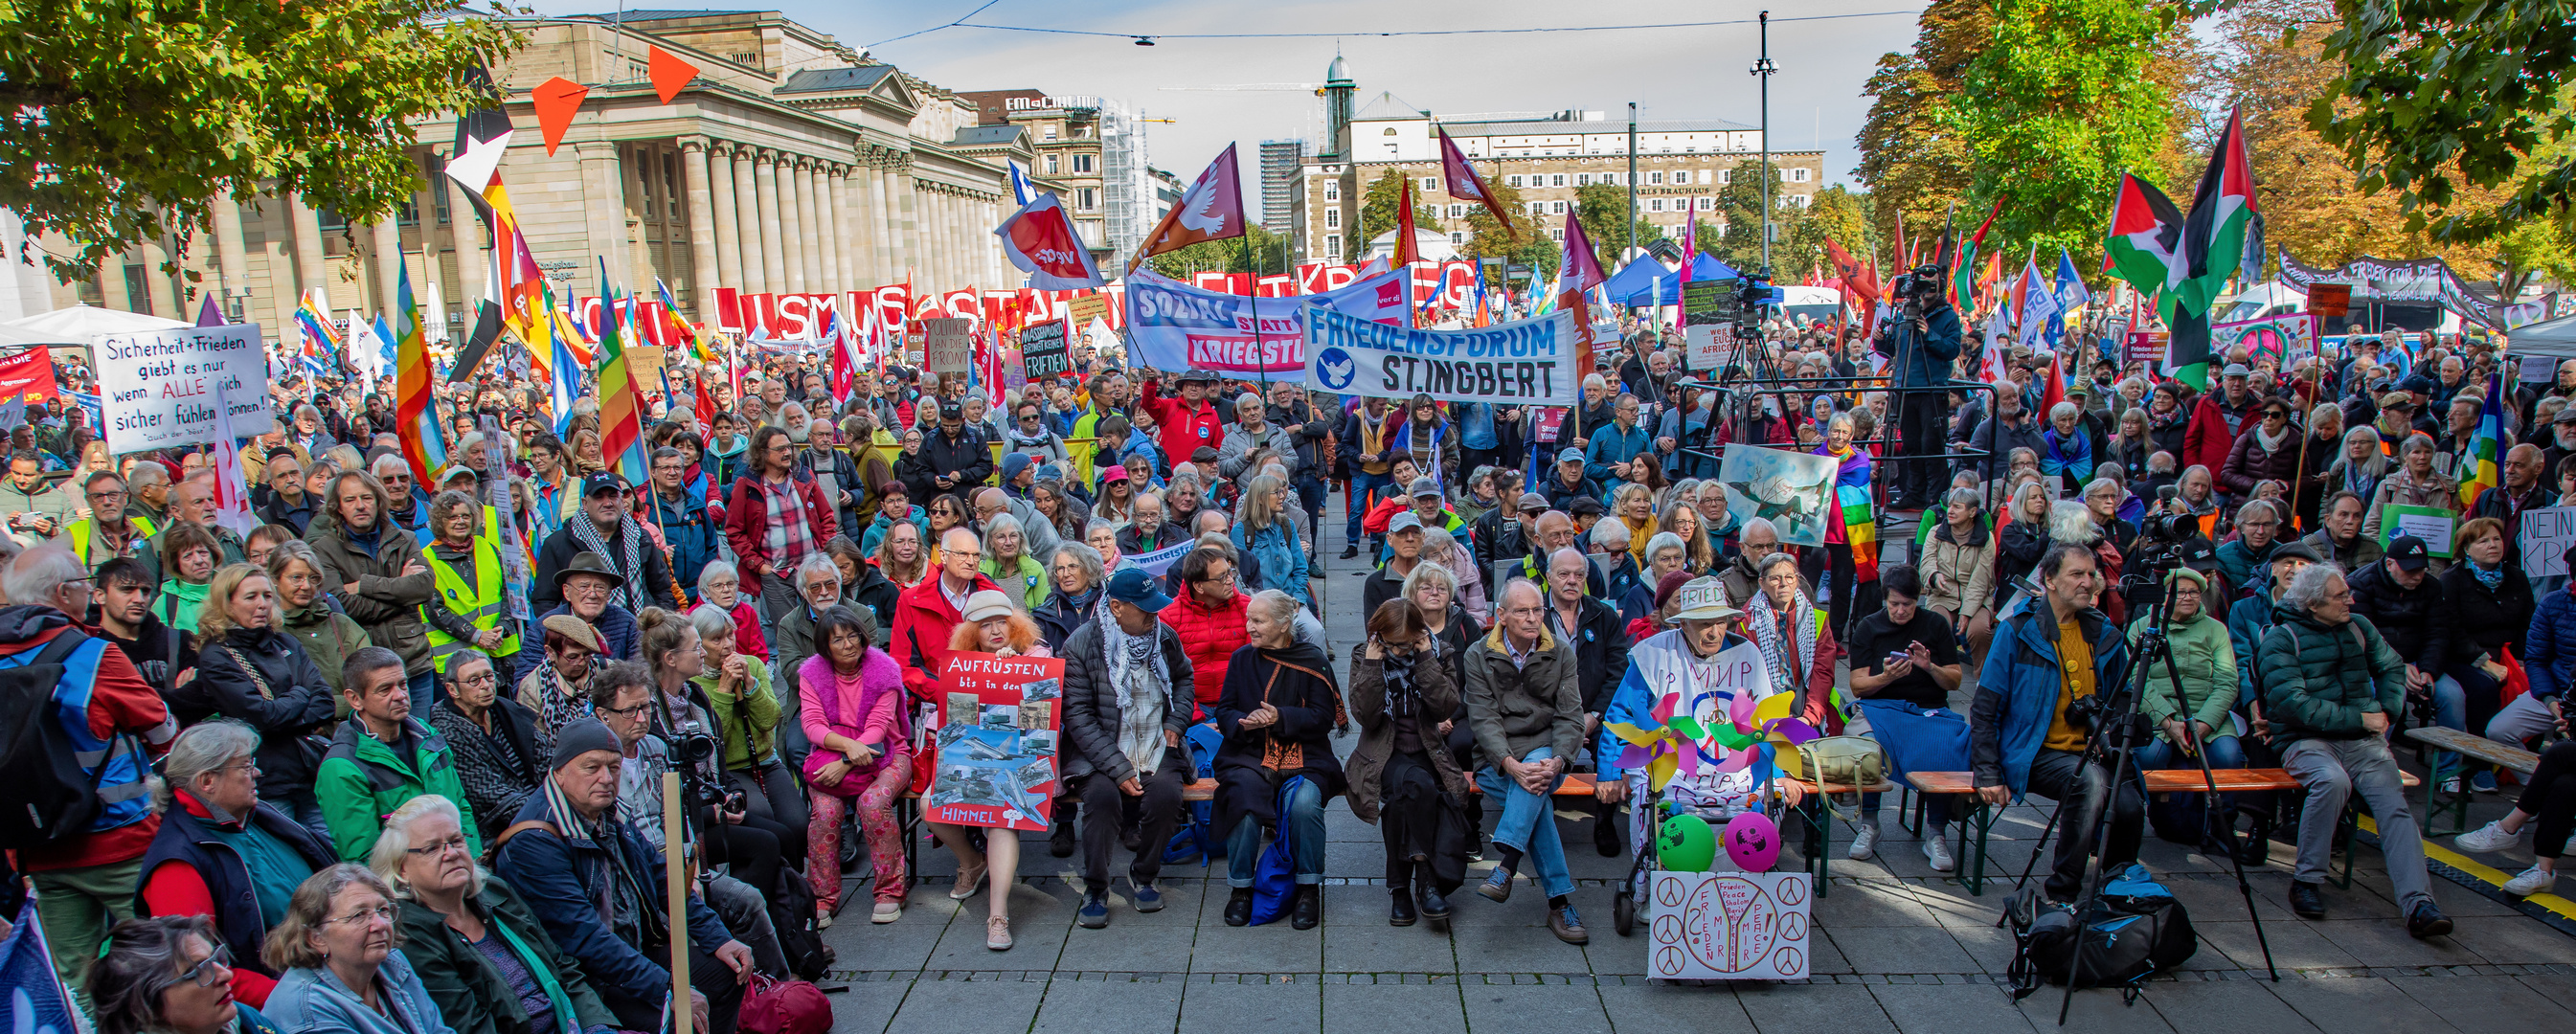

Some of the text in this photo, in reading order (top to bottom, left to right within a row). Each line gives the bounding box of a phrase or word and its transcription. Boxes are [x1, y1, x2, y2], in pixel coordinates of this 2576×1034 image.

[1634, 186, 1709, 197] ARLS BRAUHAUS
[1140, 289, 1229, 322] SOZIAL
[929, 318, 969, 336] POLITIKER
[1237, 317, 1292, 331] STATT
[1310, 307, 1556, 357] FRIEDENSFORUM
[935, 339, 962, 348] AN DIE
[2289, 337, 2312, 350] NOT
[12, 354, 32, 364] DIE
[933, 350, 969, 366] FRONT
[138, 360, 225, 380] giebt es nur
[1382, 355, 1556, 398] ST.INGBERT
[25, 393, 42, 402] LPD
[113, 389, 147, 403] wenn
[162, 378, 207, 399] ALLE
[117, 395, 266, 431] sicher fühlen önnen!
[1789, 511, 1803, 522] NATO
[2524, 511, 2572, 540] NEIN
[2523, 541, 2570, 575] KRI
[1683, 587, 1723, 605] FRIED
[947, 657, 1046, 676] AUFRÜSTEN
[960, 677, 1020, 690] bis in den
[941, 807, 996, 823] HIMMEL
[1719, 882, 1746, 890] Frieden
[1753, 904, 1763, 954] PEACE
